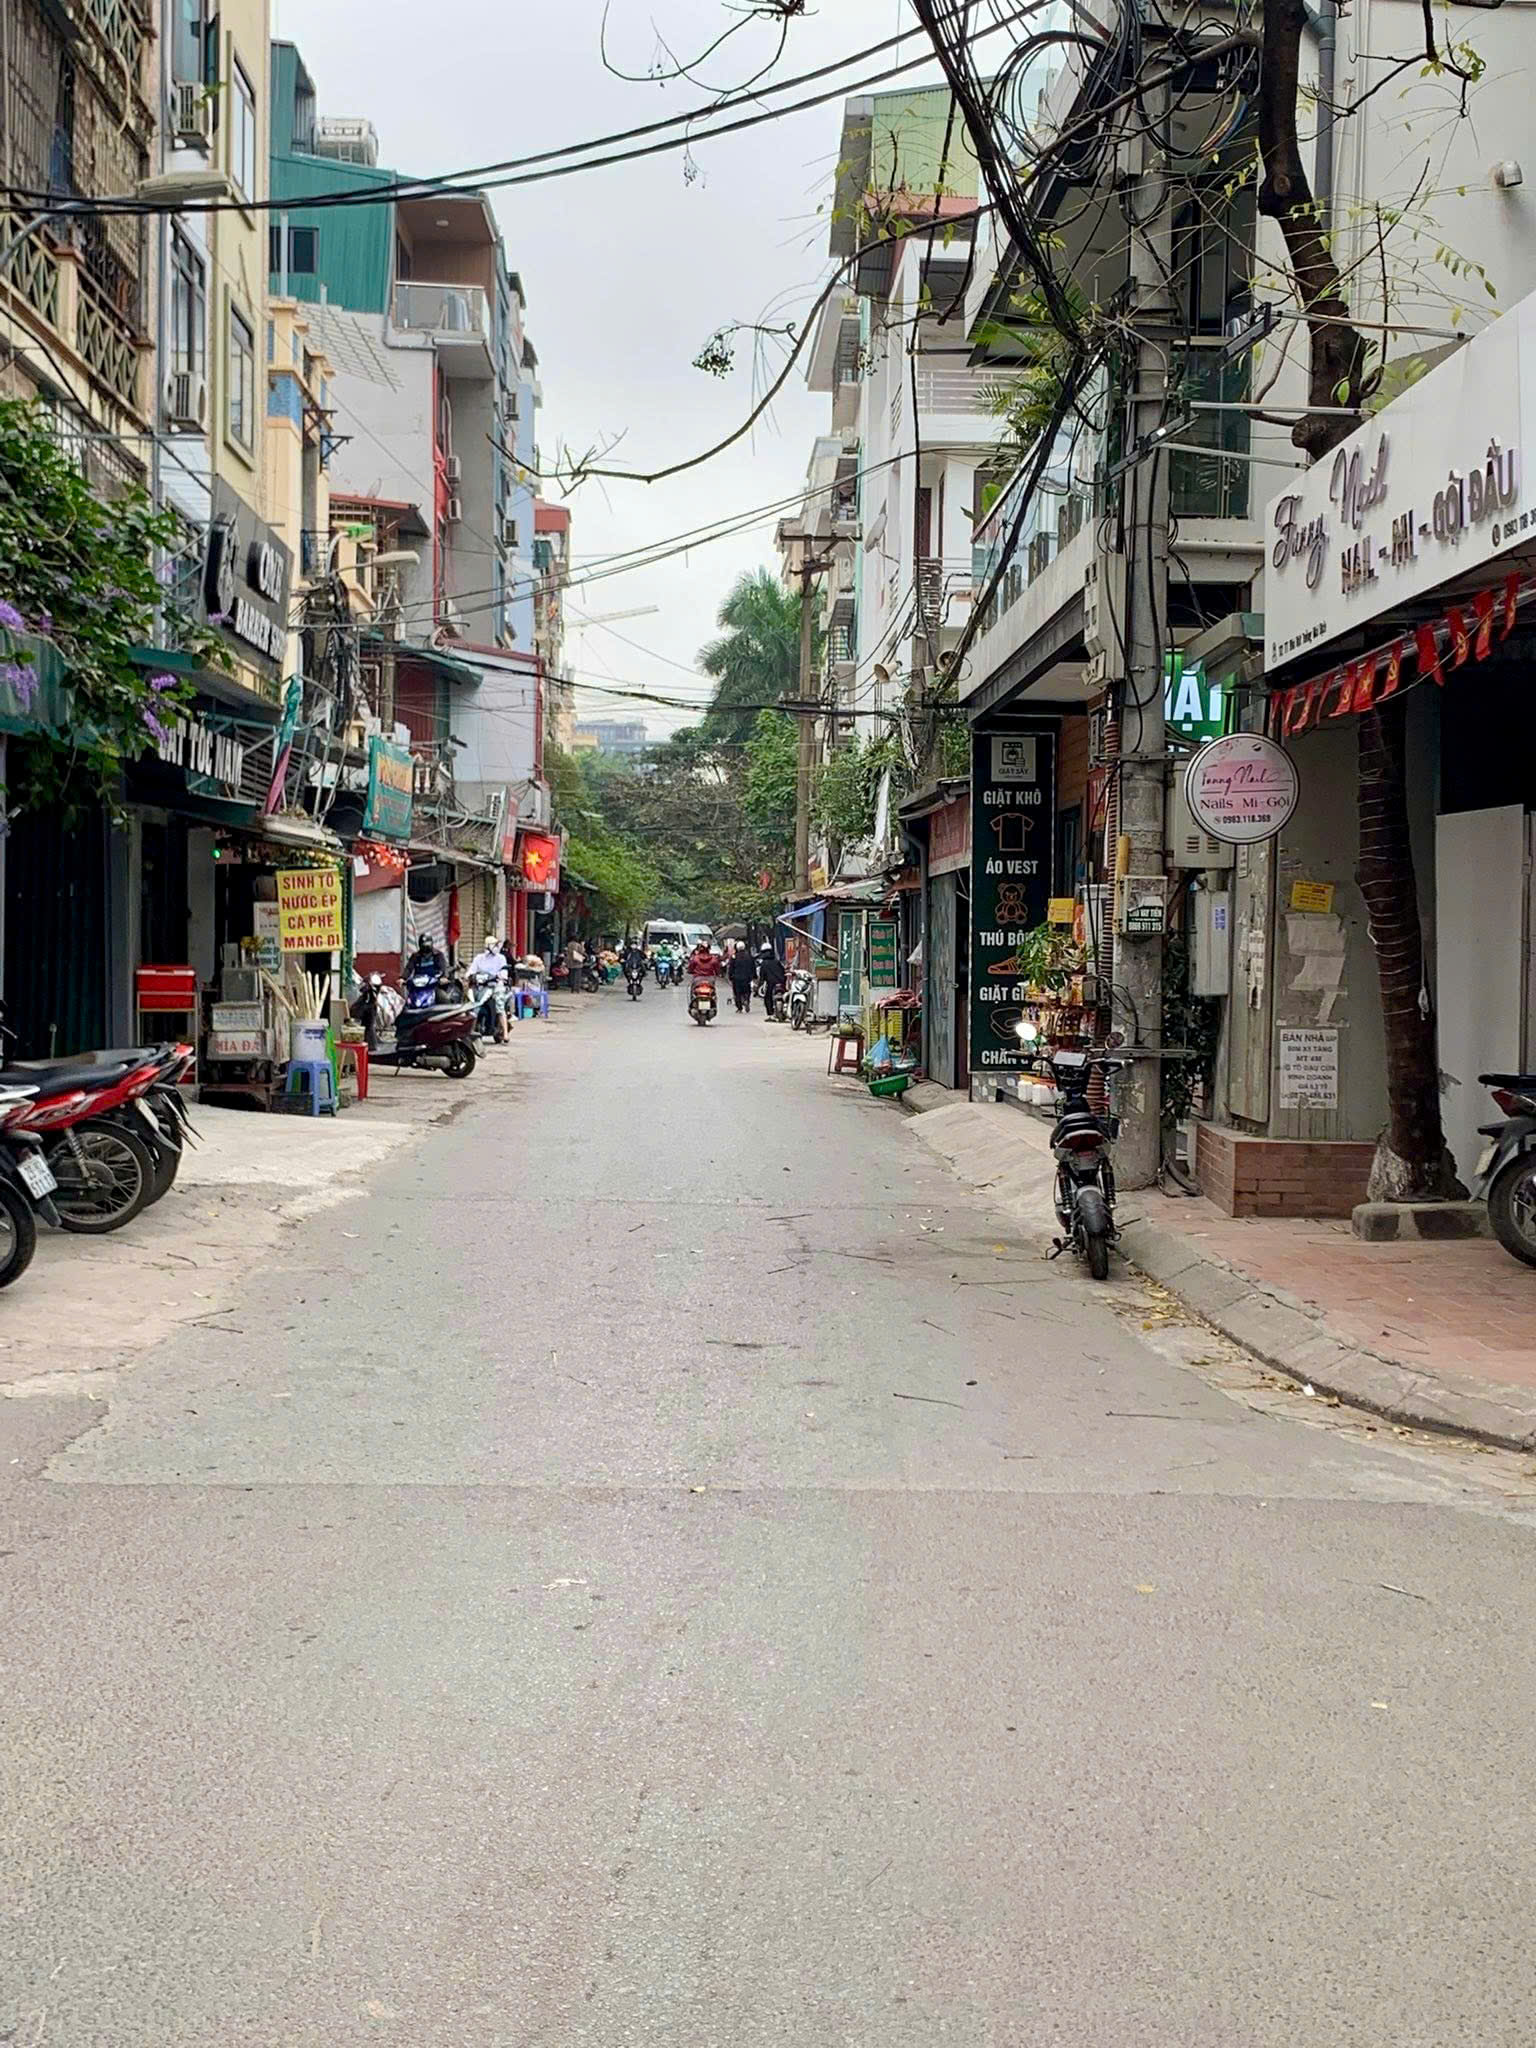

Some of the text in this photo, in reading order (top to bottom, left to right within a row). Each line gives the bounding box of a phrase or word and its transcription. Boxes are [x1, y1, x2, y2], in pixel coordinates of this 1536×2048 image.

[1342, 535, 1377, 594] NAIL
[983, 788, 1042, 808] GIẶT KHÔ
[1200, 798, 1234, 809] Nails
[985, 857, 1039, 875] ÁO VEST
[283, 875, 315, 890] SINH
[281, 893, 318, 910] NƯỚC
[308, 911, 334, 928] PHÊ
[284, 935, 323, 948] MANG
[980, 928, 1004, 946] THÚ
[980, 985, 1008, 1004] GIẶT
